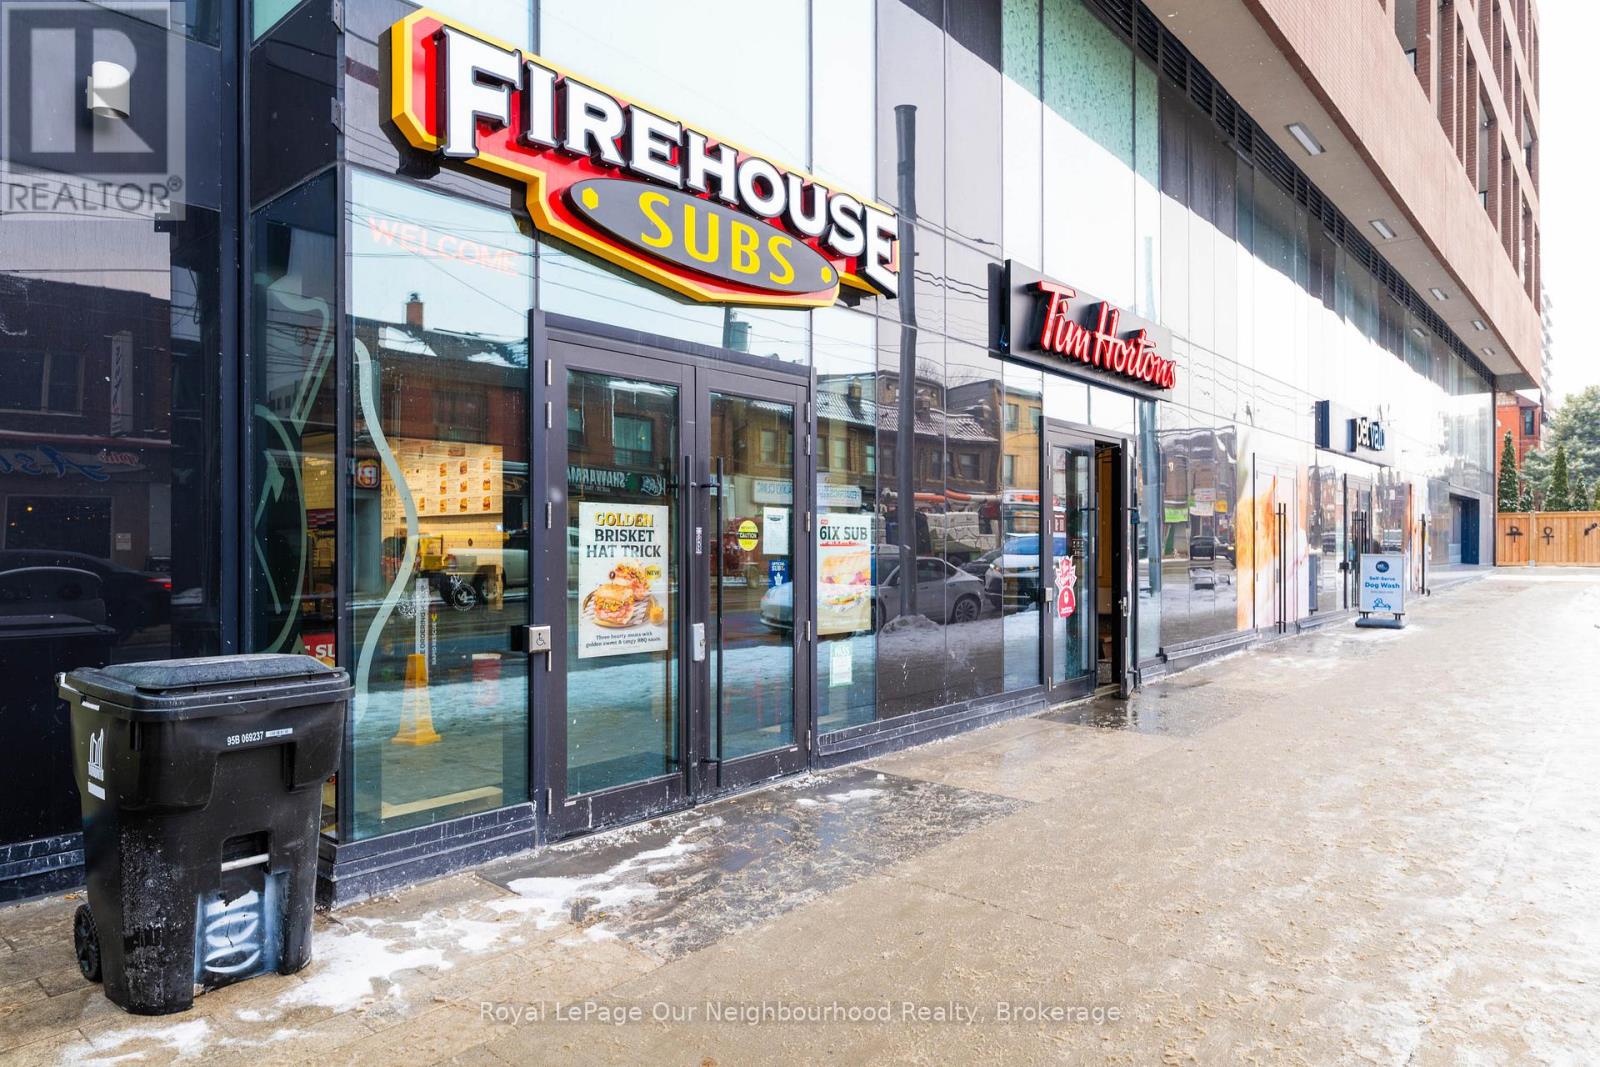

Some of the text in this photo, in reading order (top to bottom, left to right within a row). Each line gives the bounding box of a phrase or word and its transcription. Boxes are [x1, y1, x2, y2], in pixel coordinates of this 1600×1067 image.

[441, 24, 900, 299] FIREHOUSE
[637, 190, 796, 286] SUBS
[367, 215, 520, 277] WELCOME
[1037, 280, 1177, 390] Tim Hortons
[594, 511, 654, 527] GOLDEN
[594, 528, 655, 542] BRISKET
[819, 526, 868, 540] 6IX SUB
[586, 544, 661, 558] HAT TRICK
[1364, 581, 1379, 589] Dog
[227, 734, 240, 746] 95B
